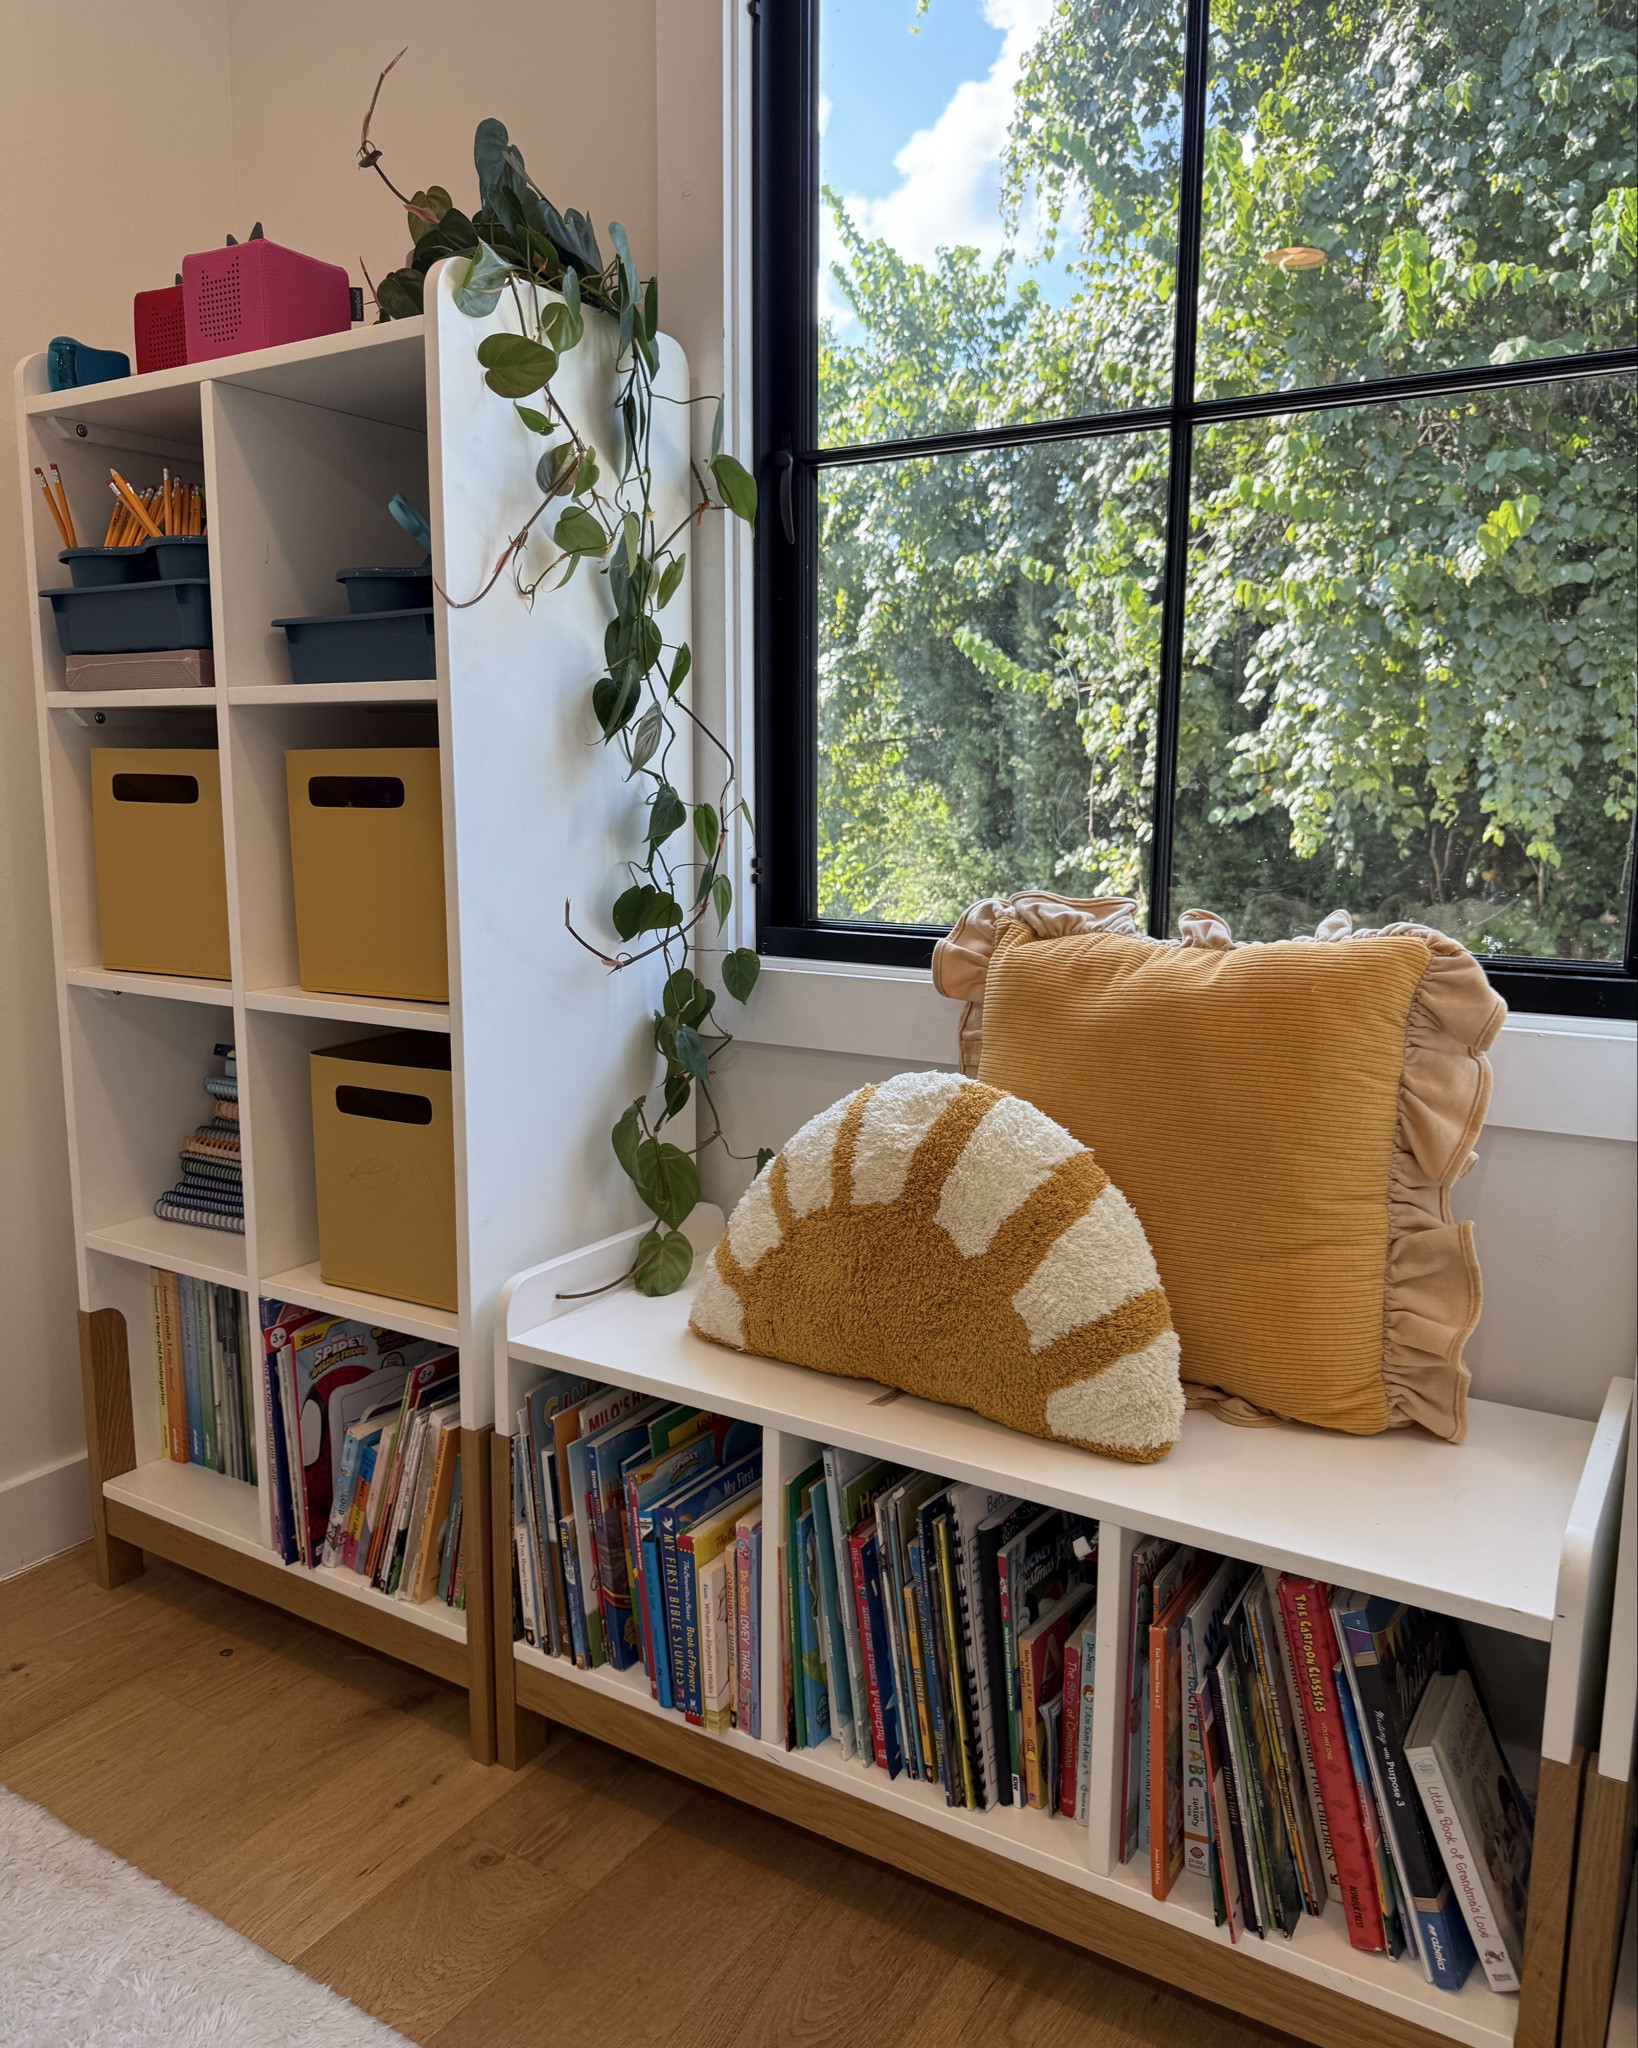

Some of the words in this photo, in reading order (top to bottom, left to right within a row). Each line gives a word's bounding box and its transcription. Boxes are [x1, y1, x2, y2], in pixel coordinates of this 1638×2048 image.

[164, 1315, 172, 1340] Grade
[272, 1333, 285, 1344] 3+
[313, 1335, 365, 1366] SPIDEY
[157, 1356, 167, 1406] Kindergarten
[420, 1369, 432, 1379] 3+
[588, 1395, 630, 1433] MILO'S
[723, 1480, 736, 1497] My
[736, 1467, 755, 1491] First
[590, 1469, 598, 1487] BEYOND
[594, 1498, 603, 1527] HORIZON
[664, 1533, 675, 1551] MY
[666, 1556, 678, 1592] FIRST
[681, 1560, 690, 1571] The
[739, 1569, 748, 1583] Dr.
[912, 1570, 922, 1583] All
[522, 1579, 530, 1607] Caterpillar
[726, 1571, 734, 1630] CORDUROY'S
[740, 1583, 749, 1612] Seuss's
[914, 1585, 925, 1608] Kinds
[1294, 1593, 1310, 1620] THE
[669, 1596, 680, 1630] BIBLE
[703, 1603, 711, 1624] When
[686, 1626, 695, 1648] Book
[741, 1613, 750, 1645] LOVEY
[918, 1615, 932, 1656] Animals
[1298, 1619, 1319, 1667] CARTOON
[687, 1650, 696, 1660] of
[705, 1639, 713, 1671] Elephant
[1085, 1642, 1095, 1654] Dr.
[687, 1661, 697, 1693] Prayers
[742, 1649, 752, 1681] THINGS
[1066, 1661, 1077, 1679] The
[1085, 1654, 1094, 1672] Seuss
[707, 1673, 715, 1694] Walks
[1066, 1680, 1077, 1704] Story
[1306, 1665, 1327, 1714] CLASSICS
[1066, 1707, 1076, 1719] of
[1083, 1712, 1092, 1725] Am
[1371, 1707, 1391, 1746] Writing
[1187, 1714, 1201, 1743] Feel
[1320, 1722, 1331, 1748] VOLUME
[1065, 1721, 1076, 1768] CHRISTMAS
[1325, 1747, 1333, 1761] ONE
[1381, 1744, 1395, 1761] with
[1187, 1749, 1204, 1789] ABC
[1385, 1758, 1404, 1799] Purpose
[1190, 1796, 1199, 1827] sensory
[1396, 1798, 1406, 1808] 3
[1426, 1783, 1449, 1816] Little
[1315, 1801, 1336, 1863] CHILDREN
[1437, 1815, 1459, 1846] Book
[1448, 1846, 1465, 1862] of
[1348, 1884, 1361, 1913] BEDROCK
[1454, 1860, 1484, 1914] Grandma's
[1353, 1912, 1364, 1930] PRESS
[1473, 1913, 1493, 1940] Love
[1428, 1934, 1450, 1973] abeka
